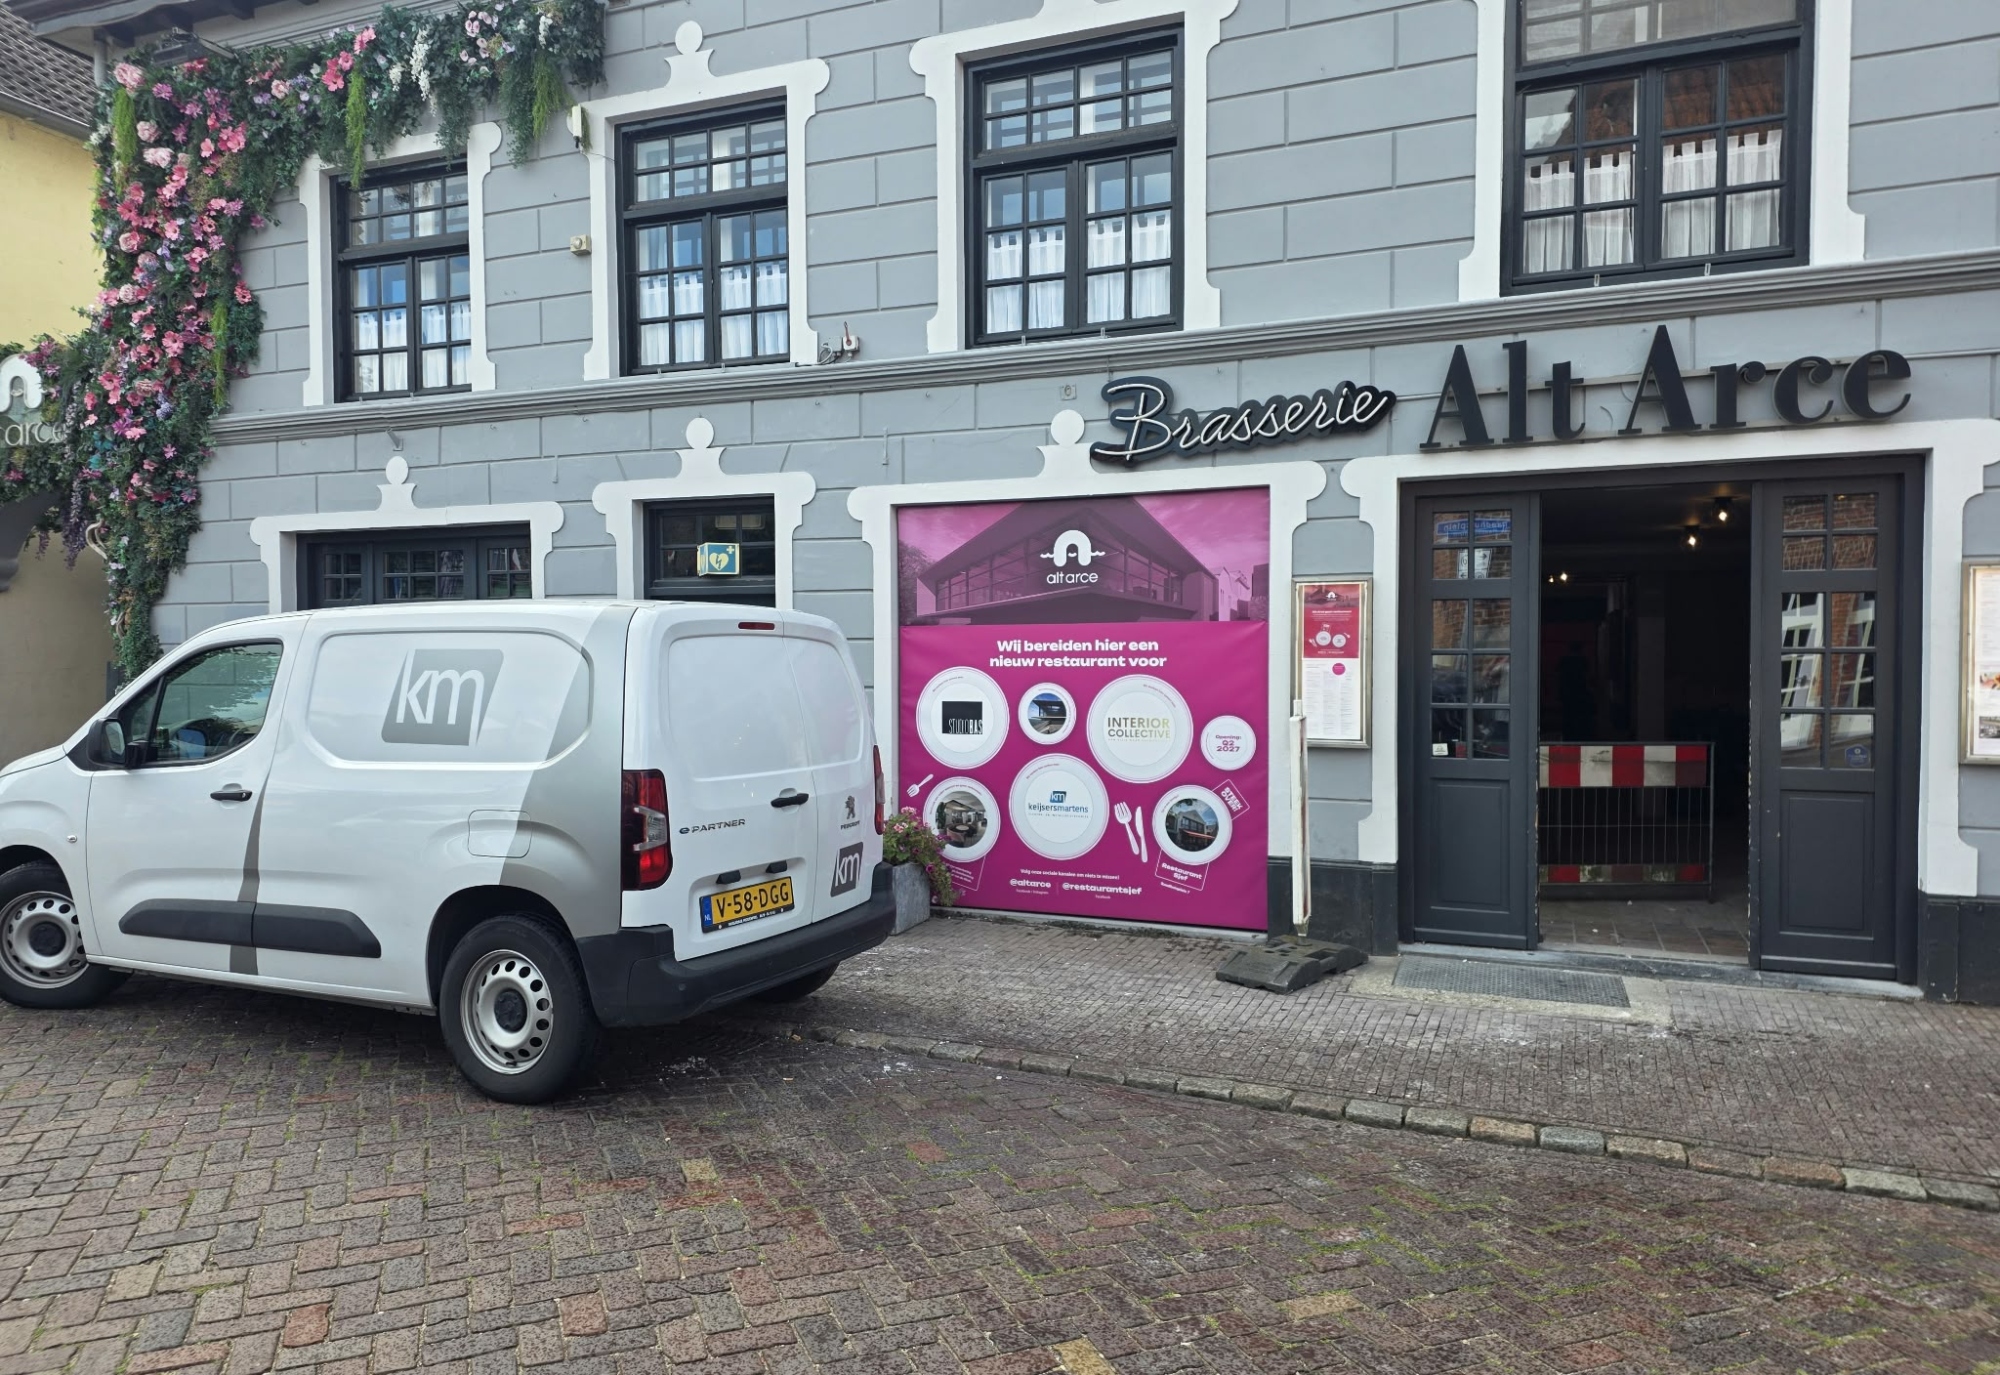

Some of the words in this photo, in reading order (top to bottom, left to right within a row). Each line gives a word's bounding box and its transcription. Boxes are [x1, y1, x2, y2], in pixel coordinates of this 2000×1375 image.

[1419, 339, 1586, 449] Alt
[1617, 324, 1912, 435] Arce
[1094, 382, 1389, 461] Brasserie
[997, 640, 1022, 653] Wij
[1024, 640, 1092, 651] bereiden
[1095, 639, 1126, 651] hier
[1128, 641, 1159, 651] een
[989, 655, 1035, 667] nieuw
[1037, 656, 1126, 667] restaurant
[1128, 657, 1167, 667] voor
[396, 649, 485, 747] km
[1107, 717, 1170, 728] INTERIOR
[1107, 728, 1171, 739] COLLECTIVE
[1028, 803, 1089, 813] keijsersmartens
[834, 850, 860, 890] km
[1161, 862, 1203, 880] Restaurant
[1062, 883, 1142, 895] @restaurantsjef
[716, 882, 789, 918] V-58-DGG
[704, 914, 712, 922] NL
